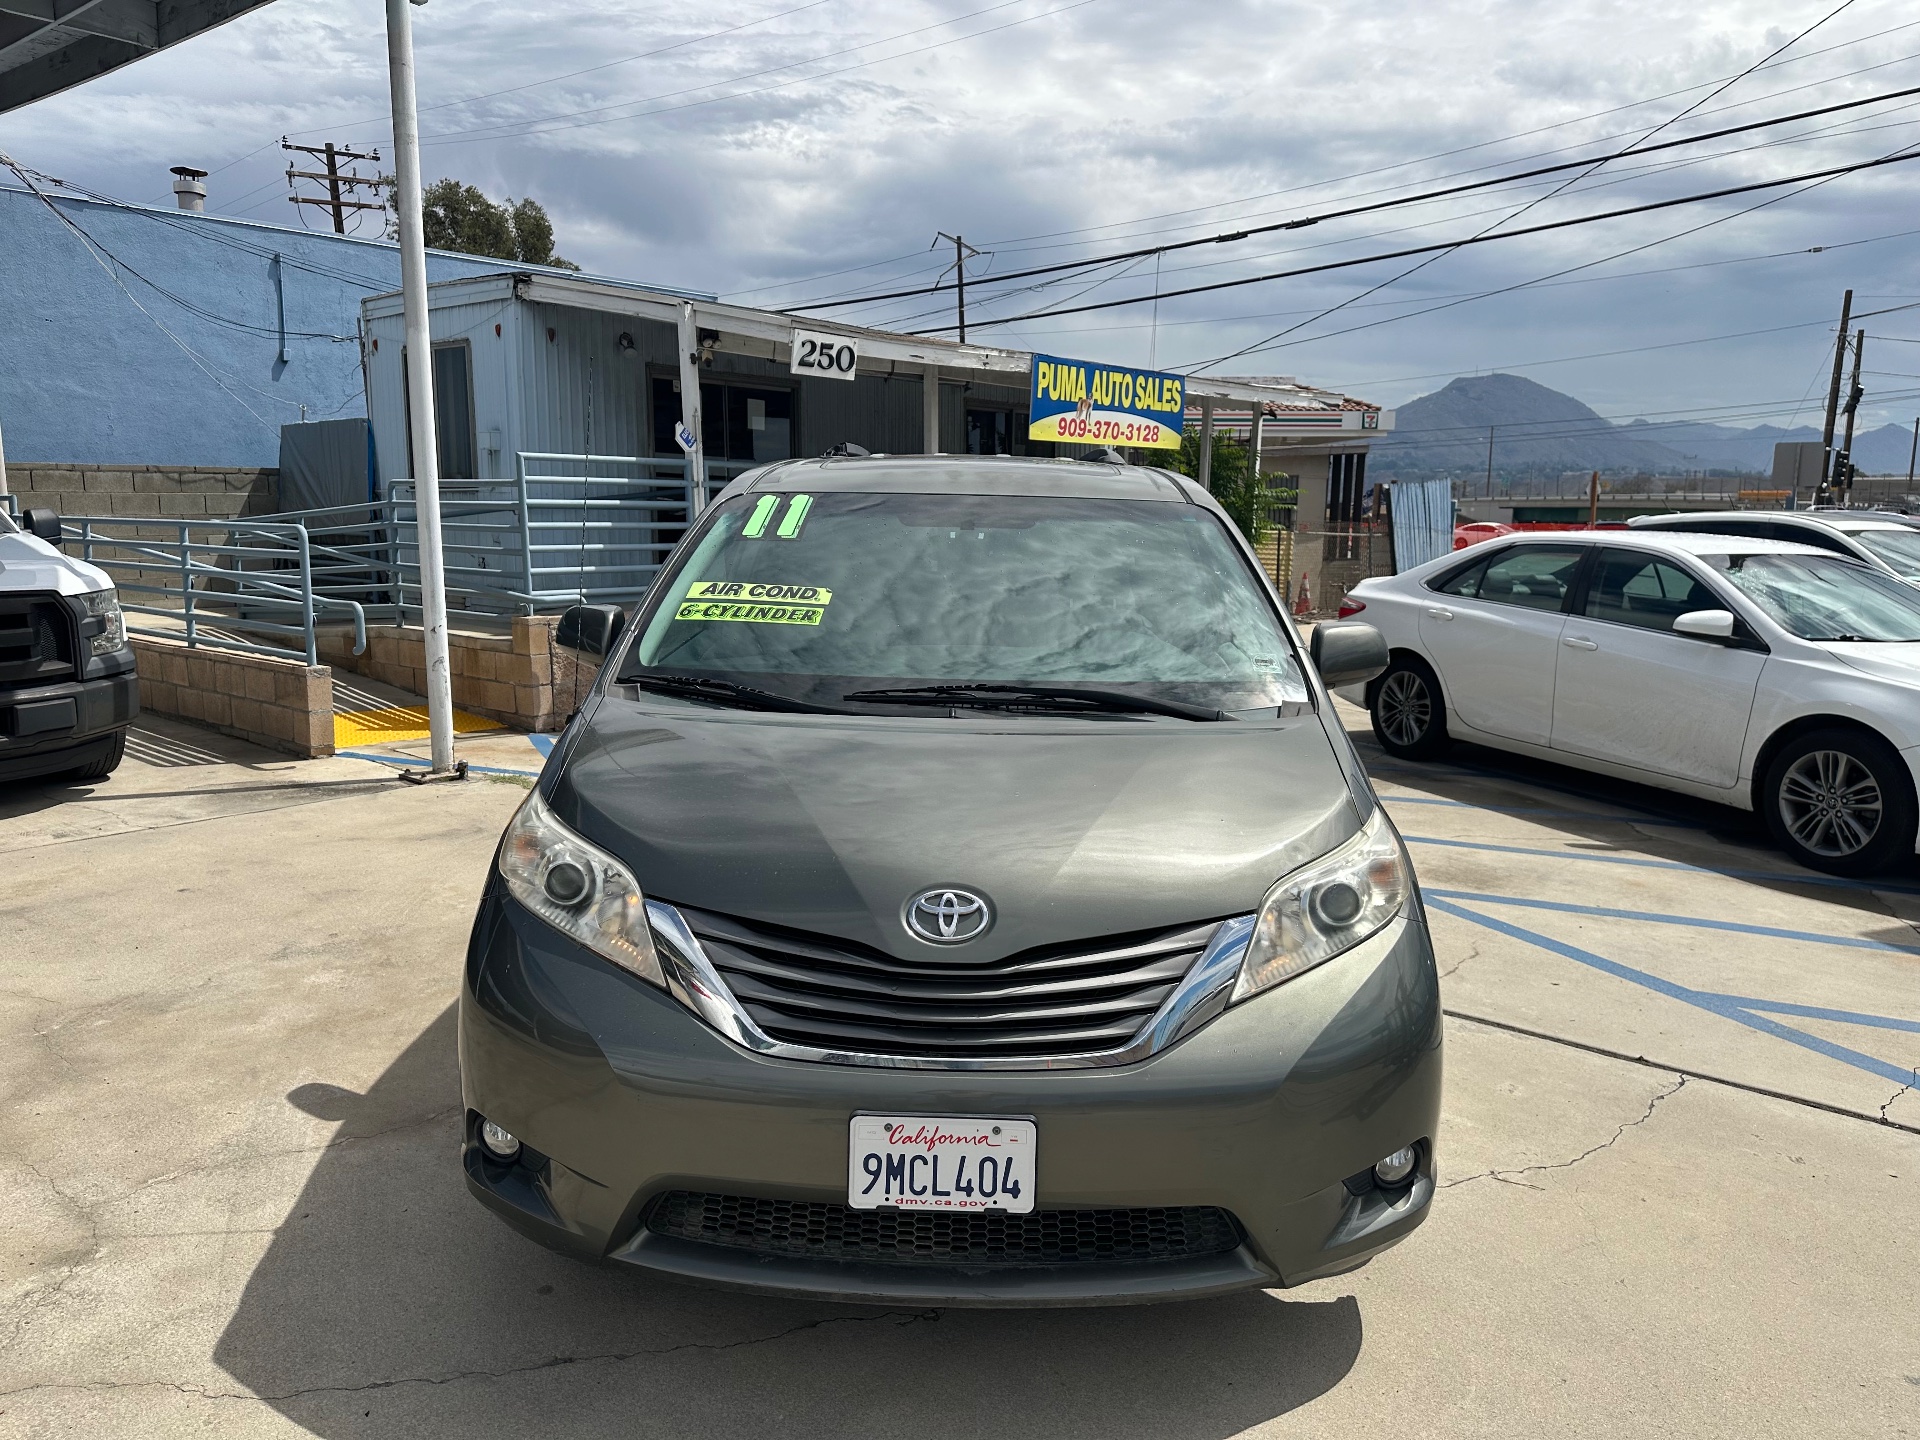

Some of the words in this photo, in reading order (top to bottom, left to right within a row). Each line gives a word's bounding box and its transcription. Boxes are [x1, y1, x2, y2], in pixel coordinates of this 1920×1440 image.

[798, 339, 855, 372] 250
[1037, 361, 1087, 403] PUMA
[1091, 369, 1133, 409] AUTO
[1134, 375, 1182, 413] SALES
[1057, 416, 1160, 443] 909-370-3128
[741, 494, 814, 539] 11
[699, 582, 746, 598] AIR
[748, 584, 822, 602] COND.
[678, 603, 822, 624] 6-CYLINDER
[888, 1124, 1001, 1152] California
[861, 1152, 1021, 1199] 9MCL404
[894, 1197, 988, 1208] dmv.ca.gov
